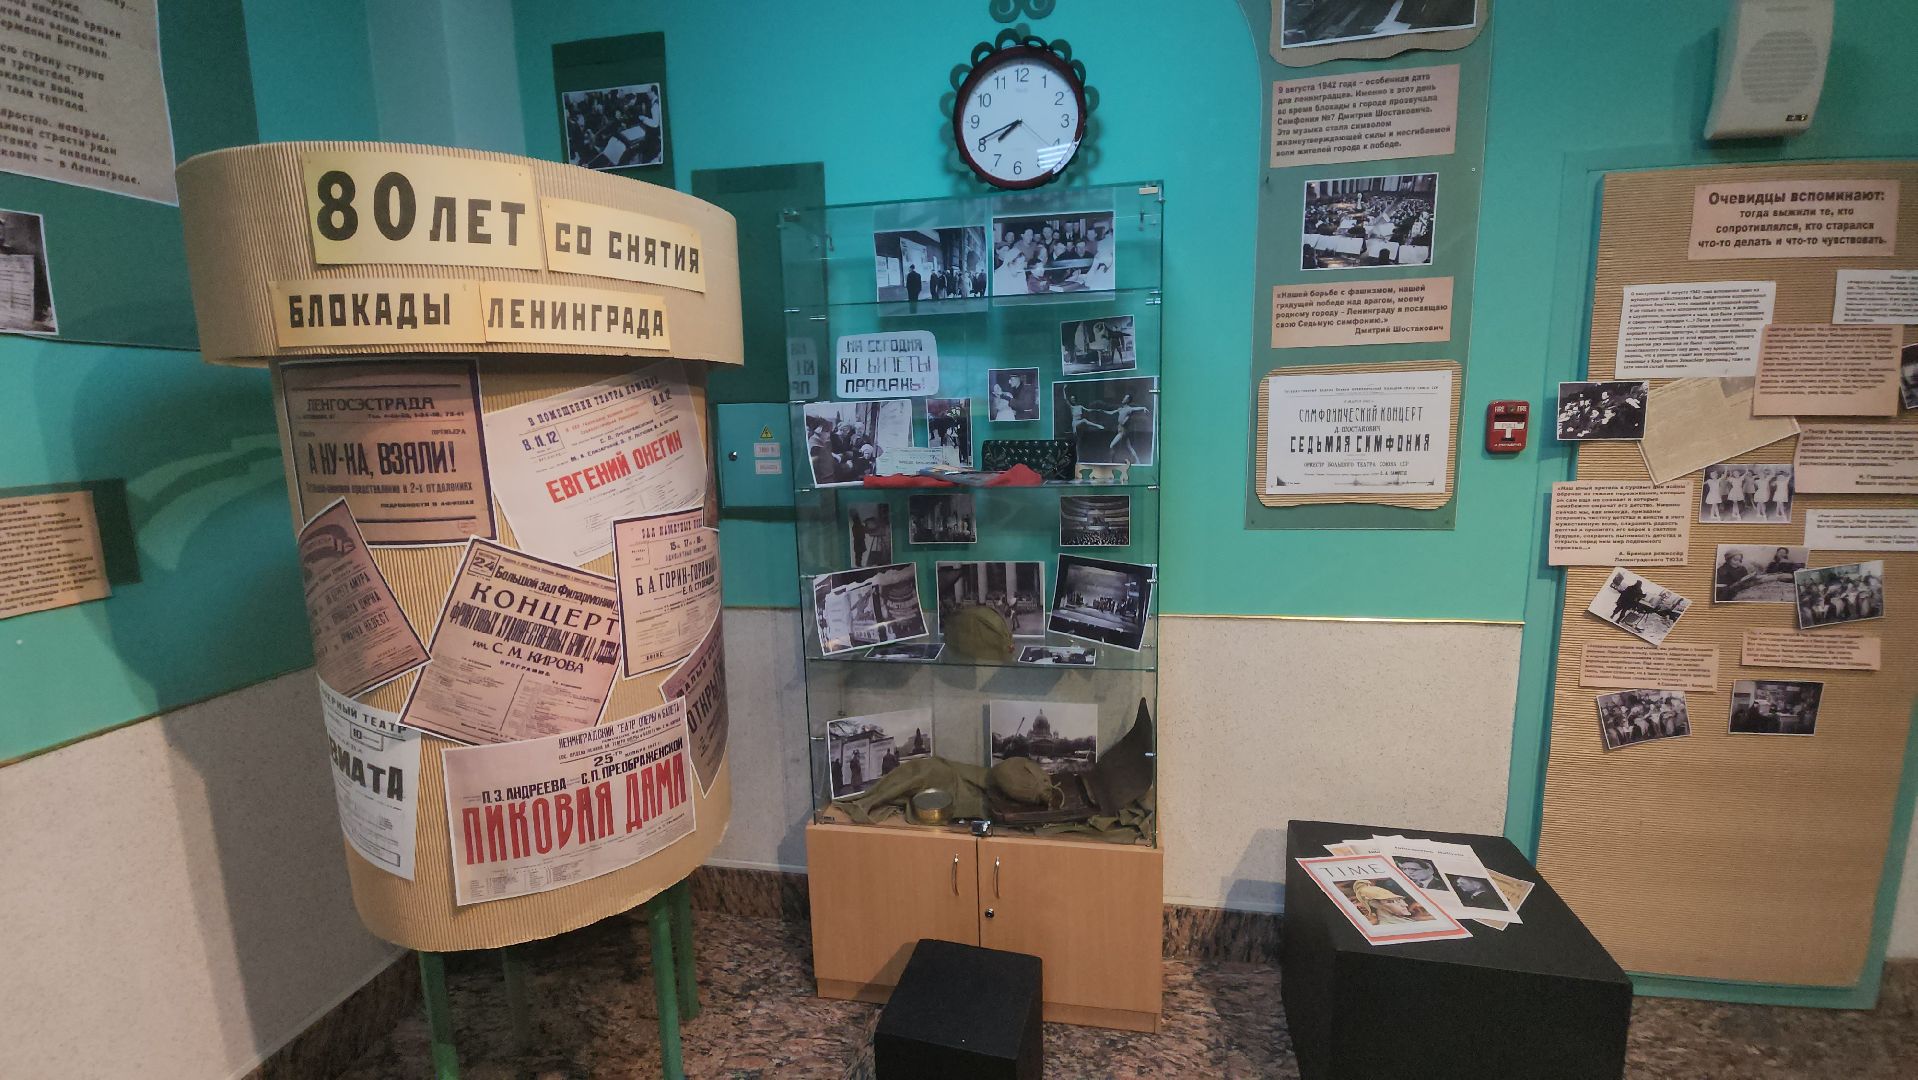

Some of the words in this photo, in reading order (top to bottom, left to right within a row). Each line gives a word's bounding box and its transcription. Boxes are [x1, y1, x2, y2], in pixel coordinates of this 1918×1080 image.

[994, 76, 1006, 90] 11
[1014, 67, 1030, 83] 12
[1042, 74, 1047, 89] 1
[1285, 84, 1315, 94] августа
[1318, 81, 1336, 89] 1942
[1339, 81, 1357, 89] года
[1365, 76, 1409, 85] особенная
[1412, 73, 1430, 82] дата
[978, 92, 992, 108] 10
[1054, 91, 1065, 106] 2
[1278, 97, 1291, 105] для
[1355, 88, 1387, 97] Именно
[1397, 86, 1414, 94] этот
[1416, 84, 1436, 93] день
[1289, 106, 1312, 115] время
[1315, 102, 1350, 112] блокады
[1359, 100, 1387, 110] городе
[1389, 95, 1437, 105] прозвучала
[970, 114, 980, 129] 9
[1060, 113, 1070, 128] 3
[1278, 114, 1319, 126] Симфония
[1321, 113, 1336, 122] №7
[1338, 111, 1373, 122] Дмитрия
[1375, 107, 1432, 117] Шостаковича.
[1277, 132, 1362, 147] жизнеутверждающей
[1364, 131, 1387, 139] силы
[1397, 125, 1451, 137] несгибаемой
[1293, 127, 1323, 136] музыка
[1351, 120, 1391, 129] символом
[977, 138, 987, 153] 8
[1297, 145, 1331, 155] жителей
[1333, 144, 1361, 153] города
[1370, 140, 1401, 150] победе.
[994, 153, 1002, 167] 7
[1013, 160, 1022, 175] 6
[1709, 192, 1786, 205] Очевидцы
[1790, 191, 1885, 202] вспоминают:
[316, 169, 417, 242] 80
[428, 196, 527, 247] ЛЕТ
[1740, 209, 1769, 219] тогда
[1772, 209, 1816, 217] выжили
[1716, 223, 1802, 234] сопротивлялся,
[1826, 222, 1874, 231] старался
[555, 222, 592, 256] СО
[608, 230, 700, 275] СНЯТИЯ
[1698, 240, 1731, 248] что-то
[1734, 238, 1772, 247] делать
[1785, 237, 1818, 245] что-то
[1822, 236, 1887, 246] чувствовать.
[1277, 290, 1308, 298] «Нашей
[1310, 289, 1338, 298] борьбе
[1348, 286, 1396, 296] фашизмом,
[1398, 284, 1425, 293] нашей
[1277, 301, 1313, 310] грядущей
[1316, 298, 1345, 307] победе
[1364, 296, 1395, 305] врагом,
[1398, 295, 1424, 304] моему
[289, 292, 451, 330] БЛОКАДЫ
[487, 297, 664, 340] ЛЕНИНГРАДА
[1275, 311, 1309, 319] родному
[1312, 310, 1339, 319] городу
[1346, 307, 1395, 316] Ленинграду
[1404, 304, 1448, 312] посвящаю
[1298, 319, 1334, 328] Седьмую
[1355, 326, 1391, 335] Дмитрий
[1393, 325, 1443, 333] Шостакович
[306, 396, 436, 412] ЛЕНГОСЭСТРАДА
[593, 389, 624, 406] ТЕАТРА
[1299, 405, 1377, 422] СИМФОНИЧЕСКИЙ
[1380, 406, 1423, 423] КОНЦЕРТ
[546, 430, 560, 444] 12
[1290, 436, 1350, 454] СЕДЬМАЯ
[1356, 434, 1430, 452] СИМФОНИЯ
[307, 442, 318, 475] А
[376, 440, 457, 475] ВЗЯЛИ!
[545, 450, 632, 504] ЕВГЕНИЙ
[631, 430, 683, 470] ОНЕГИН
[472, 556, 496, 572] 24
[494, 564, 539, 589] Большой
[538, 581, 558, 595] зал
[557, 583, 615, 609] Филармонии
[470, 581, 620, 637] КОНЦЕРТ
[450, 600, 502, 635] ФРОНТОВЫХ
[526, 650, 584, 675] КИРОВА
[361, 712, 408, 735] ТЕАТР
[558, 725, 615, 749] ЛЕНИНГРАДСКИЙ
[616, 719, 636, 734] ТЕАТР
[506, 777, 568, 801] АНДРЕЕВА
[601, 736, 684, 780] ПРЕОБРАЖЕНСКОЙ
[461, 780, 615, 866] ПИКОВАЯ
[624, 752, 687, 835] ДАМА
[1318, 863, 1386, 878] TIME
